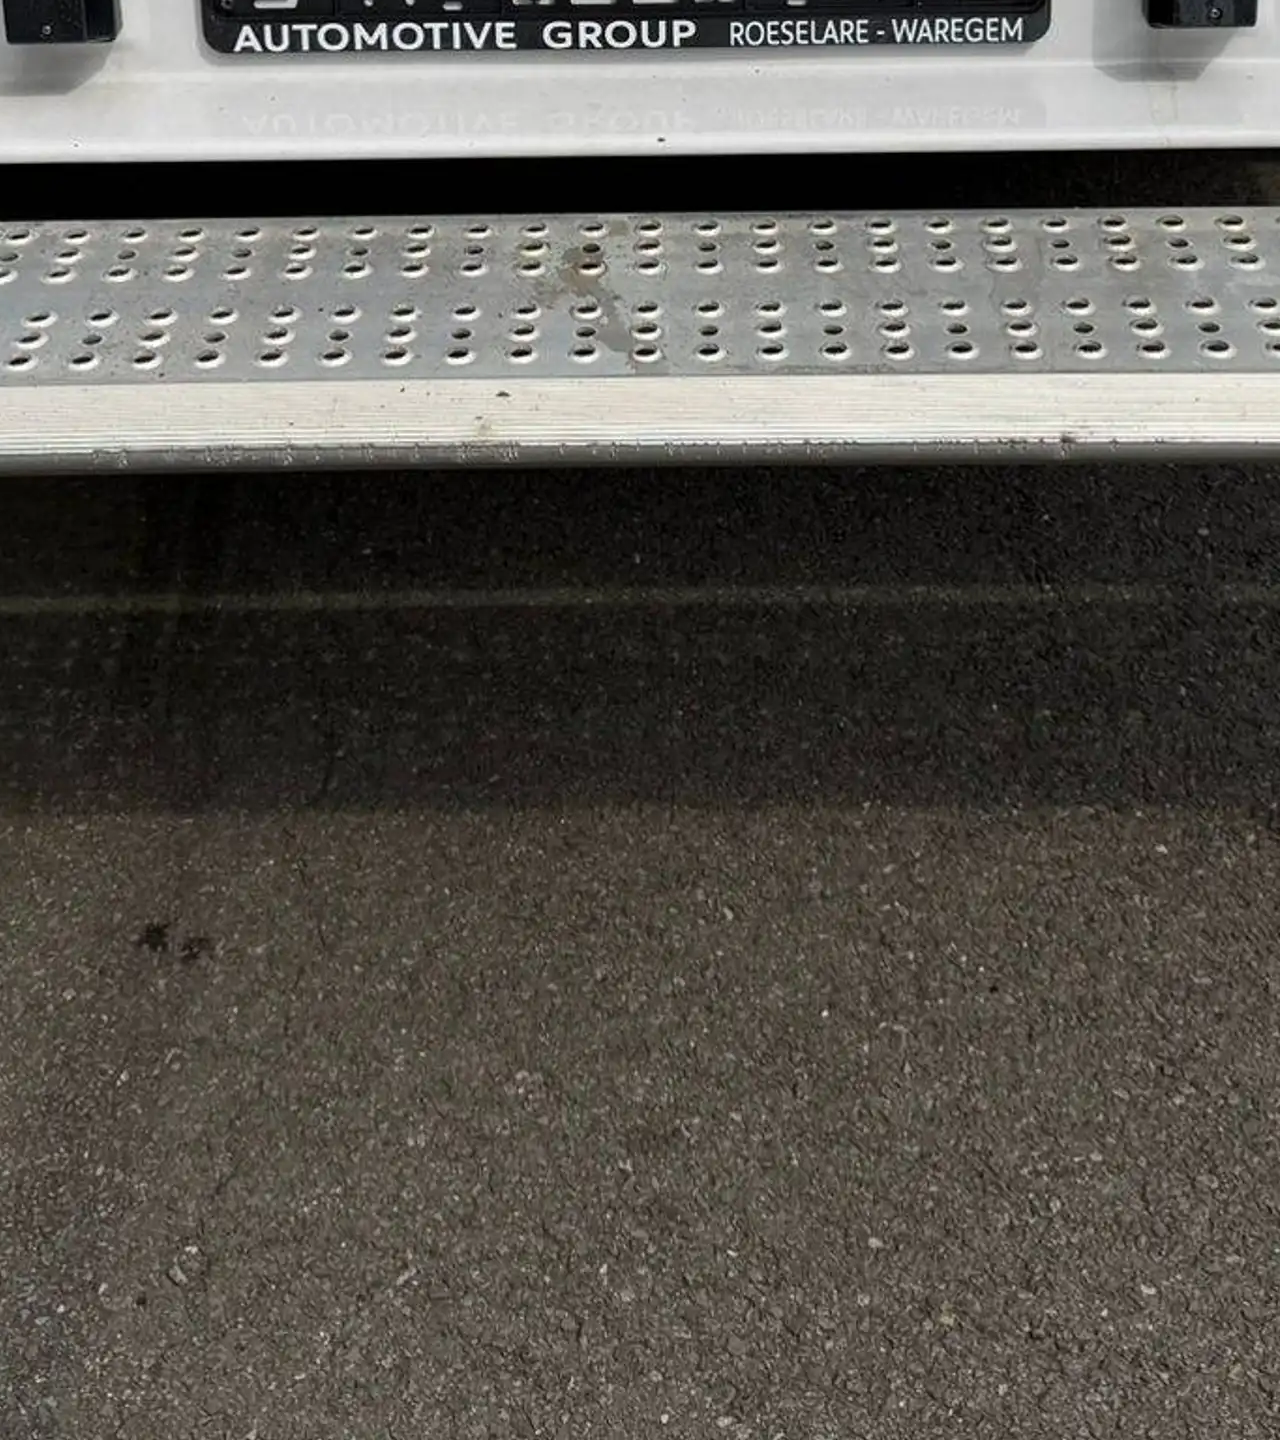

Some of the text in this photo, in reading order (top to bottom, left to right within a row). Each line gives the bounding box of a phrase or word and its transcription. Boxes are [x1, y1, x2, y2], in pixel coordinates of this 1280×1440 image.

[233, 19, 696, 52] AUTOMOTIVE GROUP
[729, 19, 869, 46] ROESELARE
[891, 17, 1023, 43] WAREGEM
